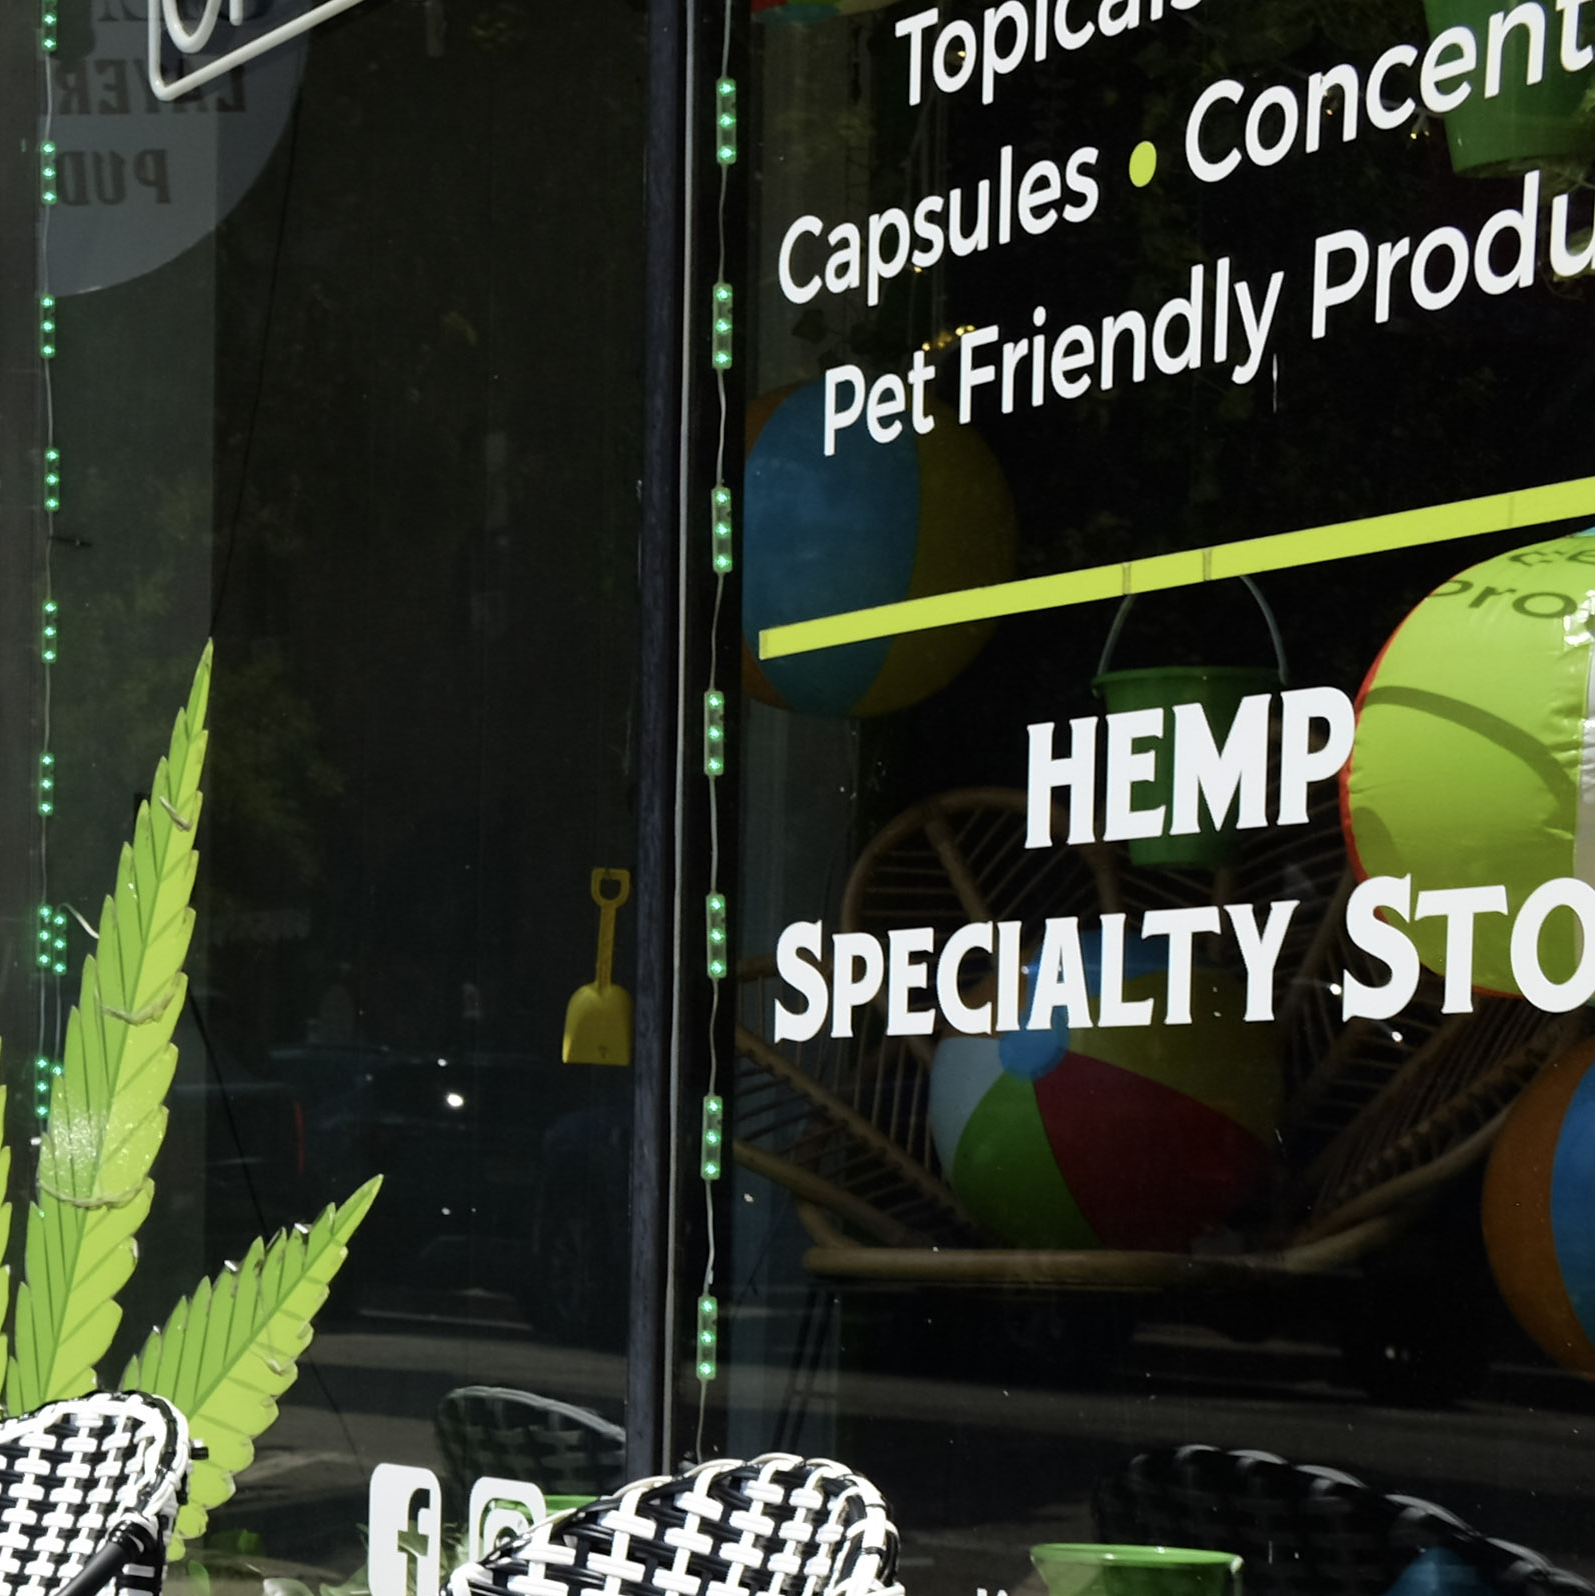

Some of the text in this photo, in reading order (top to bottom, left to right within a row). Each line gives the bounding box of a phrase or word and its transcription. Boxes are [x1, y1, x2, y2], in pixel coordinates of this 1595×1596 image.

[895, 0, 1202, 107] Topica
[778, 145, 1099, 306] Capsules
[824, 350, 935, 457] Pet
[959, 257, 1285, 425] Friendly
[1024, 686, 1356, 848] HEMP
[774, 872, 1595, 1044] SPECIALTY STO
